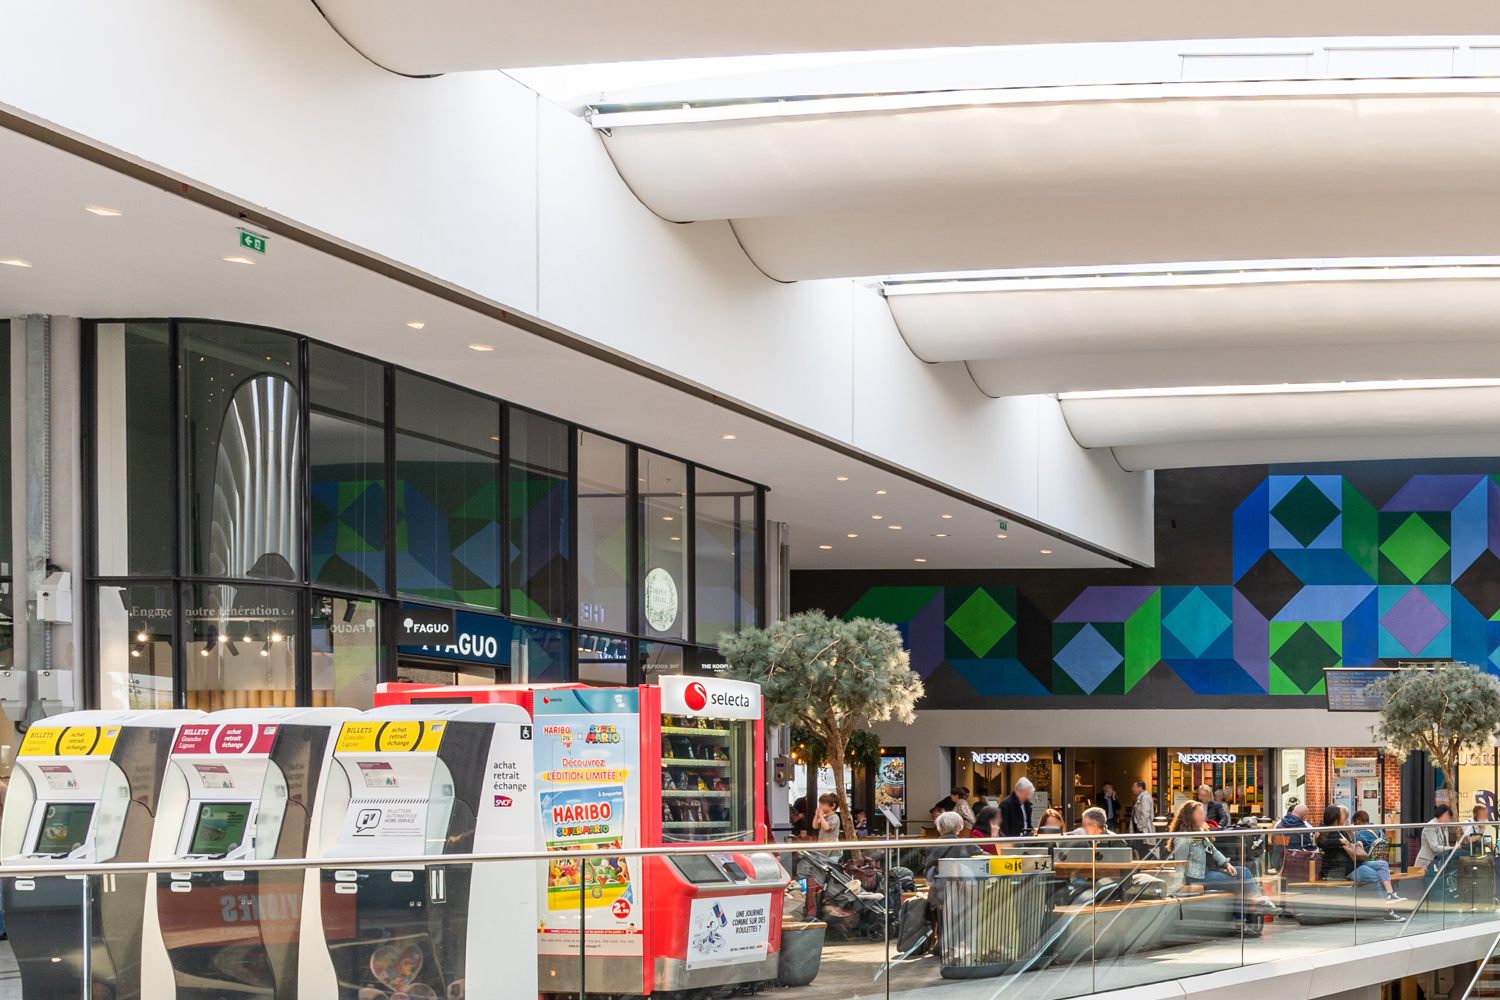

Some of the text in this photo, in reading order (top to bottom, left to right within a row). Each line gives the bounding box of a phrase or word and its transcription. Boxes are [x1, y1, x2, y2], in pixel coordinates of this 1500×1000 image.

[414, 624, 449, 633] FAGUO
[711, 692, 749, 708] selecta
[543, 725, 571, 735] HARIBO
[589, 725, 617, 733] SUPER
[585, 732, 620, 744] MARIO
[562, 758, 605, 767] Découvrez
[971, 751, 1030, 764] NESPRESSO
[1177, 752, 1236, 765] NESPRESSO
[493, 761, 516, 770] achat
[493, 771, 519, 780] retrait
[546, 770, 584, 781] L'ÉDITION
[585, 769, 617, 780] LIMITÉE
[493, 781, 527, 792] échange
[494, 798, 512, 807] SNCF
[553, 803, 611, 823] HARIBO
[556, 824, 609, 837] SUPER MARIO
[736, 910, 744, 918] UNE
[732, 918, 748, 926] COMME
